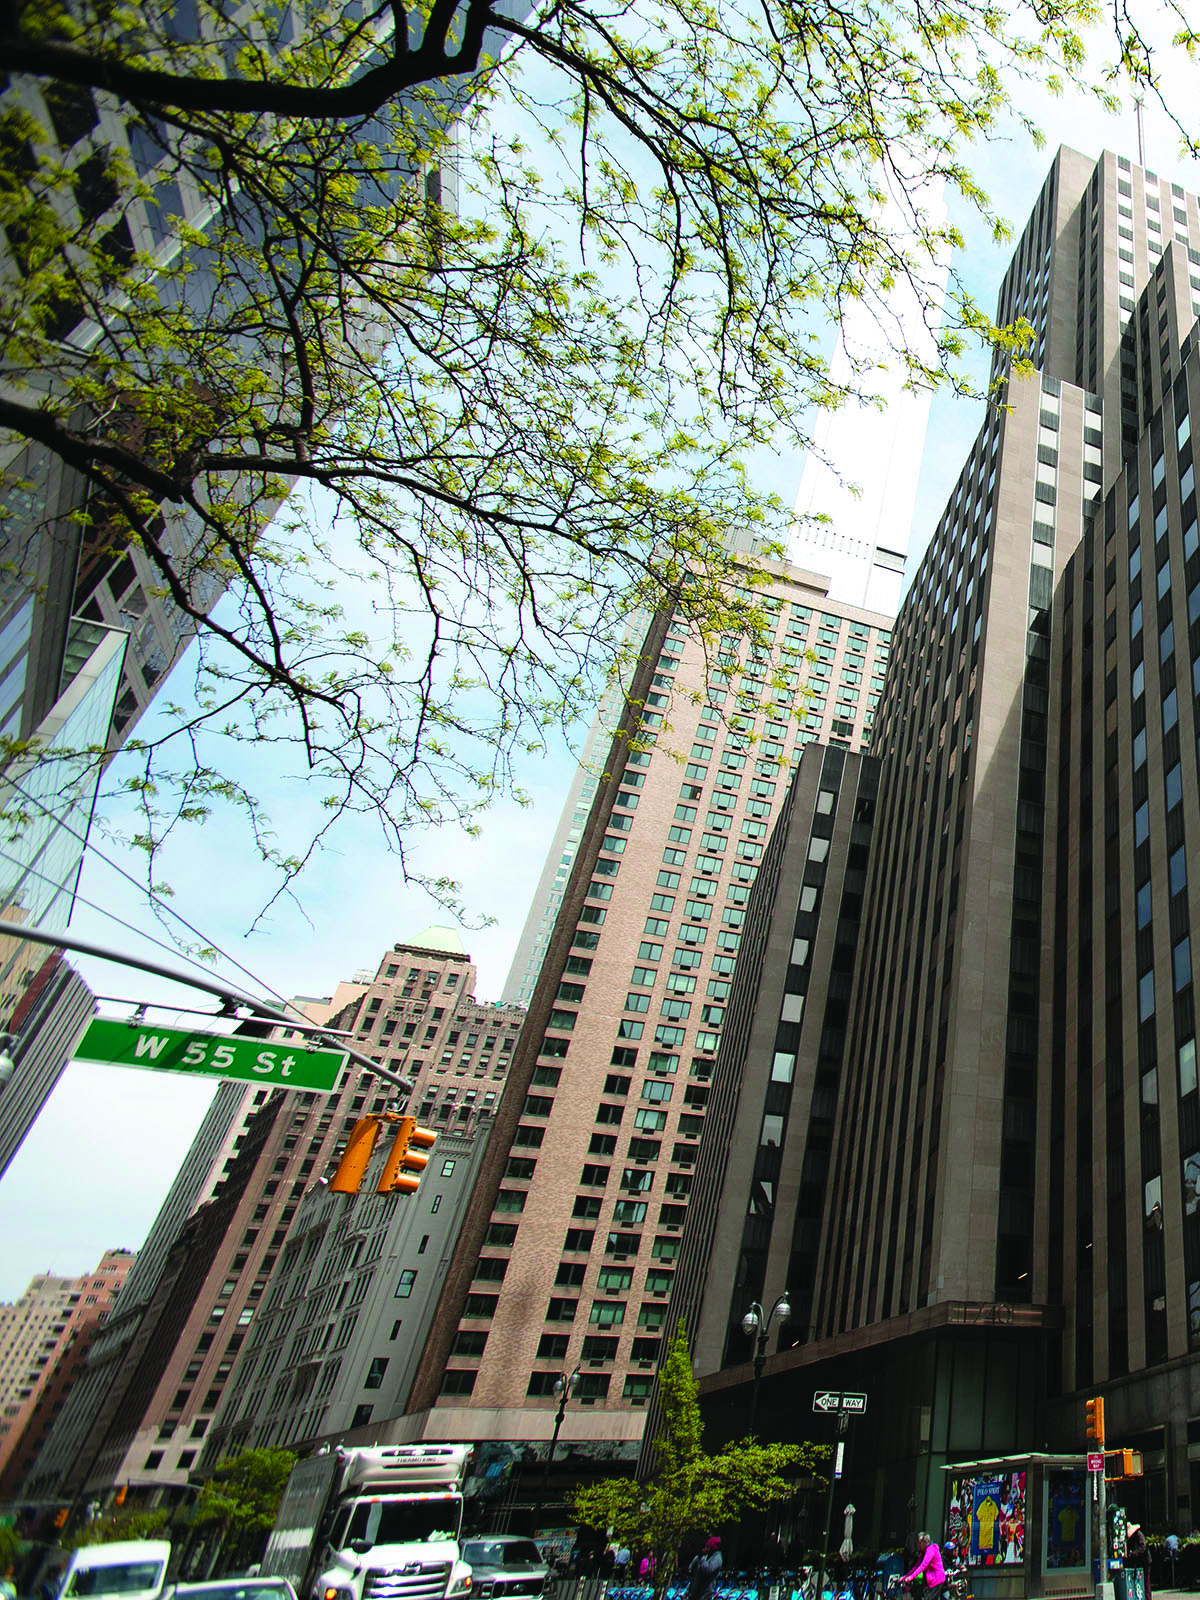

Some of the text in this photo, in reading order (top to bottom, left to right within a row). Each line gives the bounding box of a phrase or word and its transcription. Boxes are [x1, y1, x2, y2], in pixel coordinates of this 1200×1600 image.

[134, 1033, 297, 1077] W 55 St
[962, 1303, 1014, 1325] 1740
[821, 1397, 861, 1407] ONE WAY
